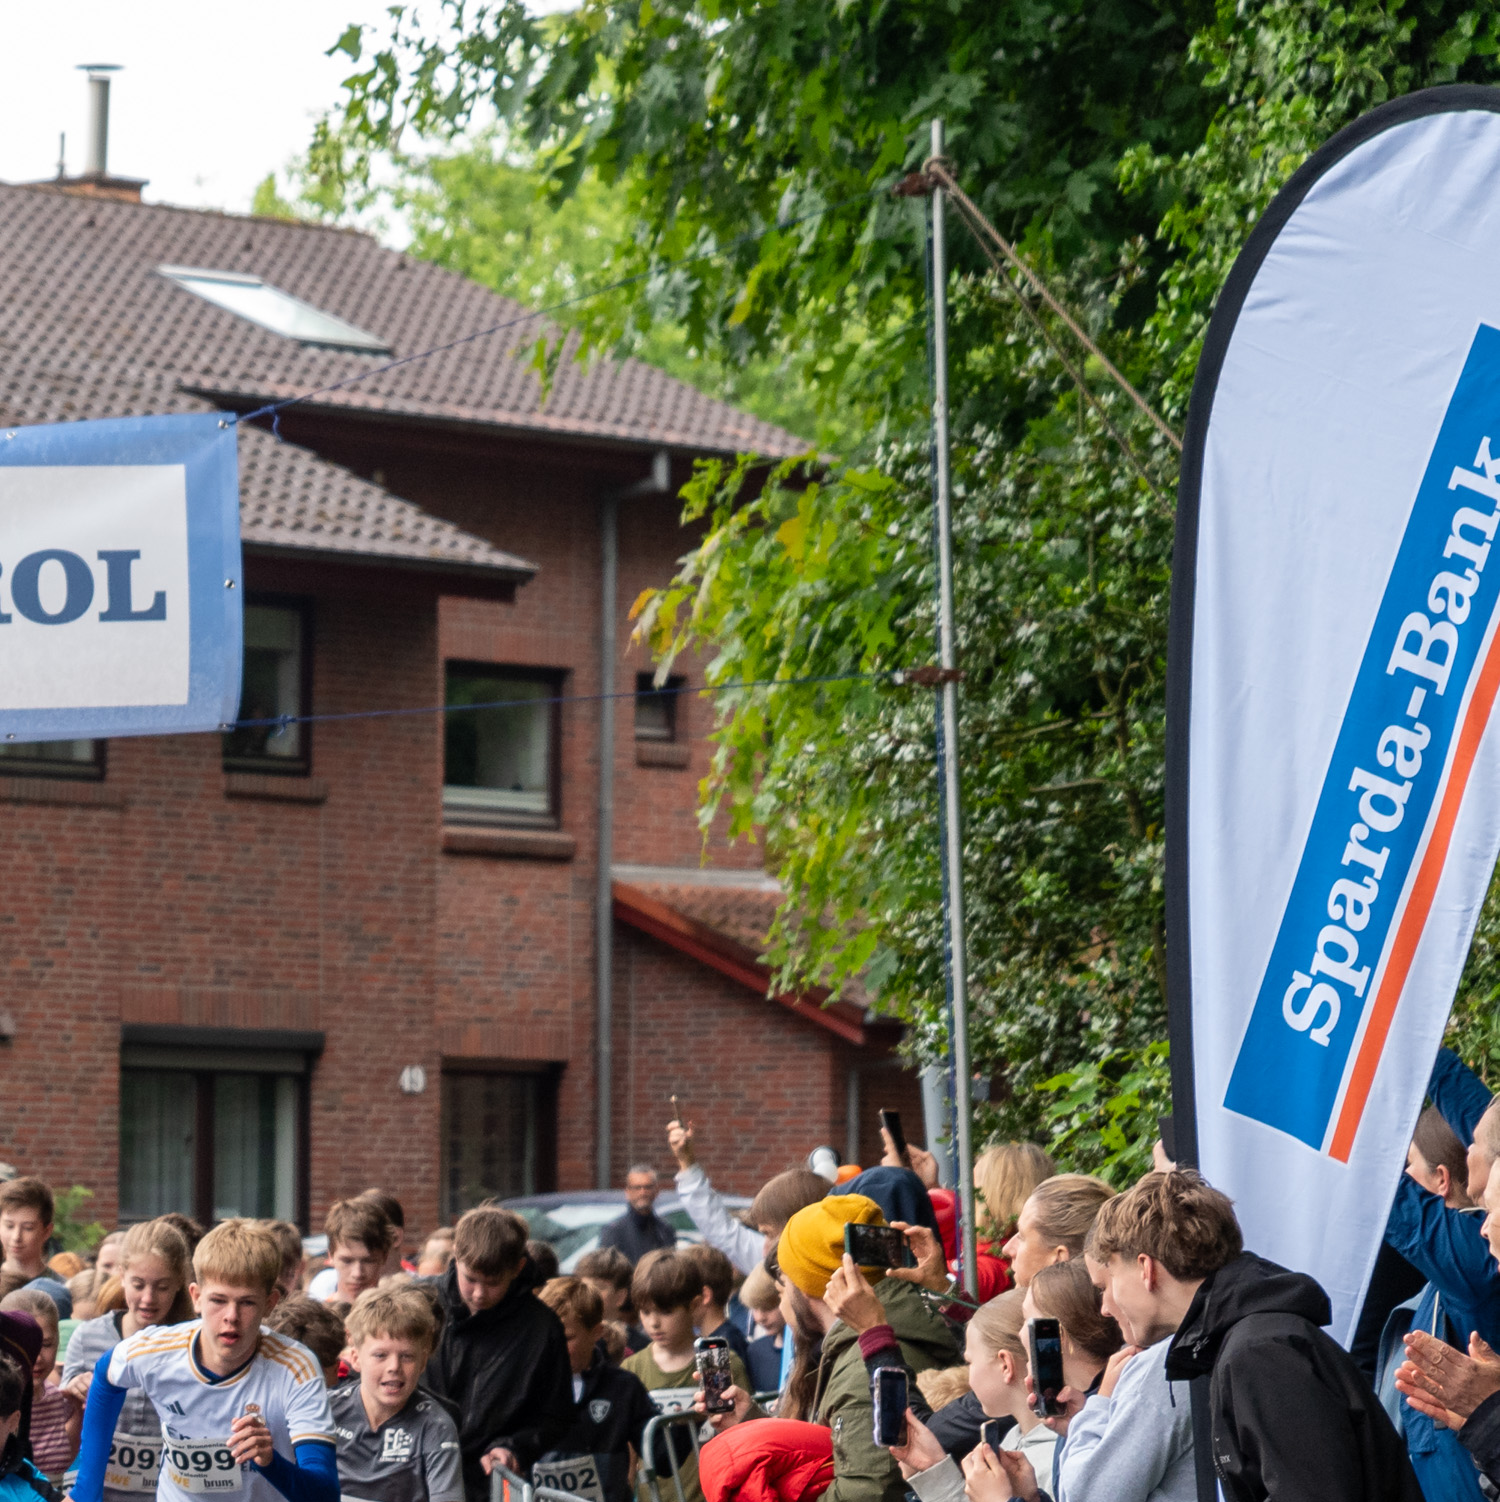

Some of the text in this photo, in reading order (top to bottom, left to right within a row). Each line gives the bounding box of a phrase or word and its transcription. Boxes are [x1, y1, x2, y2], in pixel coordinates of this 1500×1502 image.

[1283, 435, 1500, 1047] Sparda-Bank
[107, 1446, 161, 1470] 209
[142, 1477, 157, 1487] bru
[203, 1478, 234, 1489] bruns
